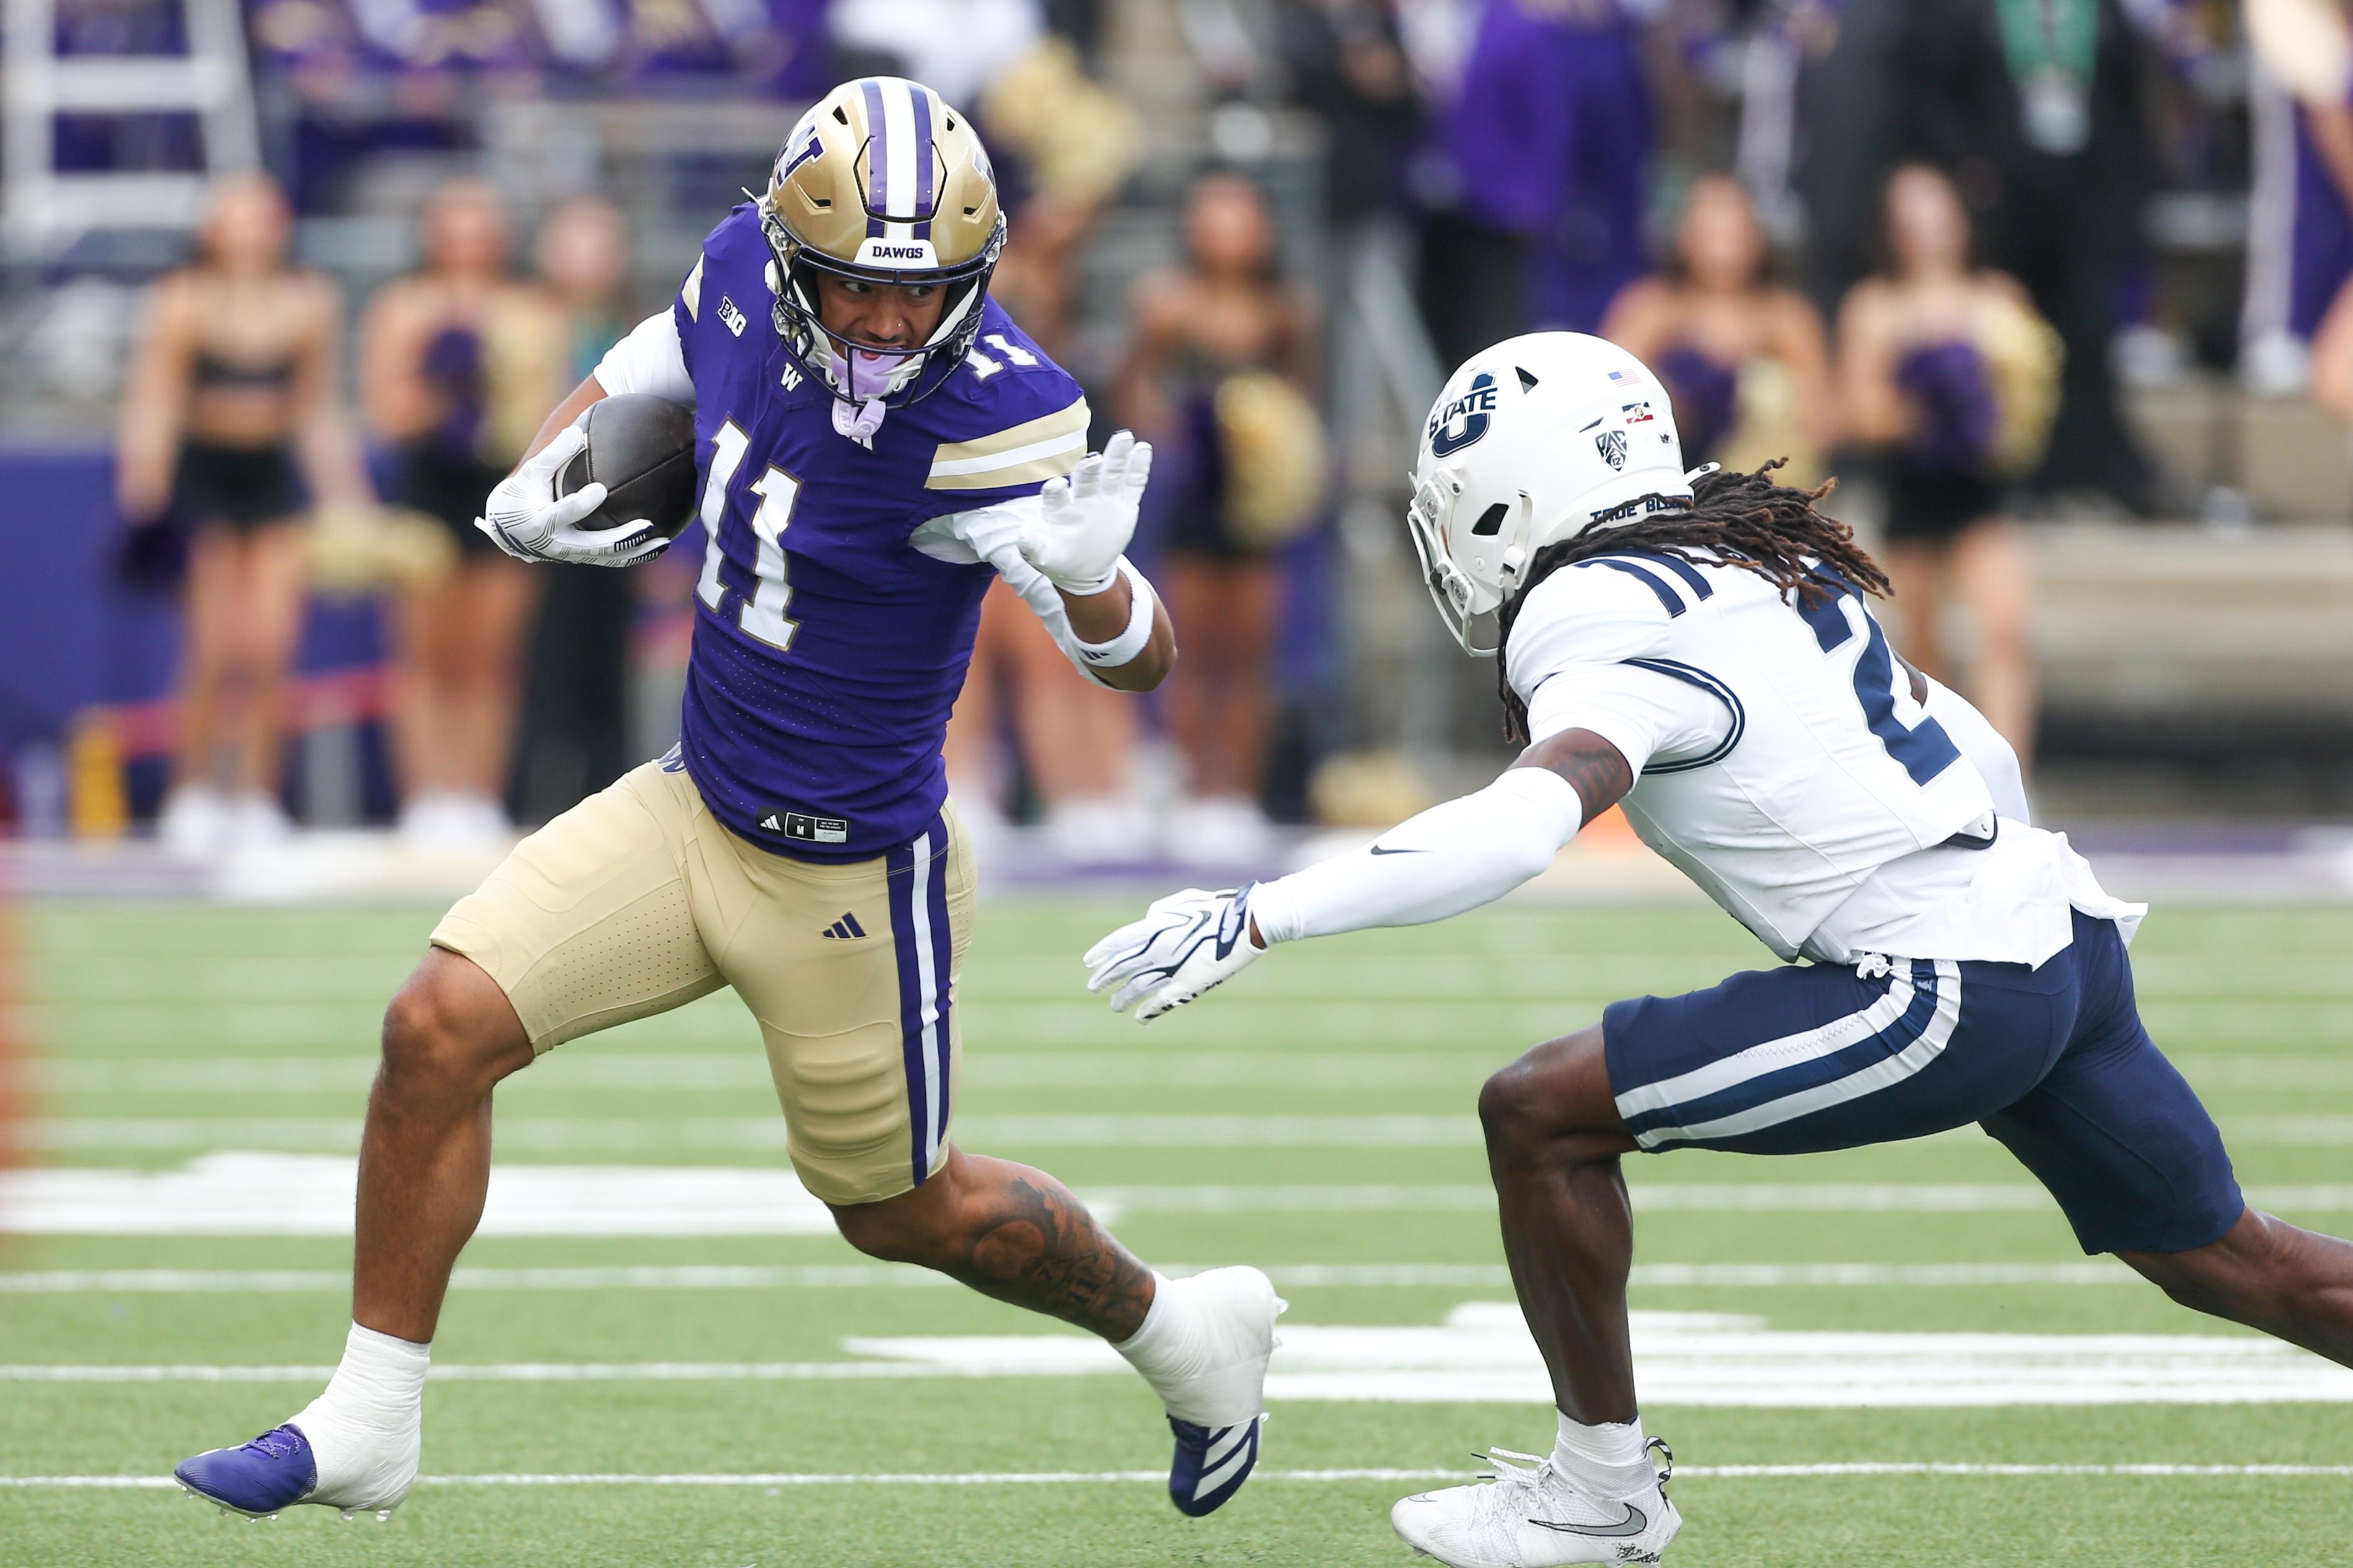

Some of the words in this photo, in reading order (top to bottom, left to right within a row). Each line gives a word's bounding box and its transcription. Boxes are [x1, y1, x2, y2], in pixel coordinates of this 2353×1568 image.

[873, 246, 923, 258] DAWGS
[964, 334, 1042, 382] 11
[781, 362, 803, 392] W
[1429, 387, 1498, 439] STATE
[1596, 431, 1627, 457] PAC
[1612, 457, 1621, 466] 12
[694, 412, 804, 653] 11
[797, 825, 804, 835] M
